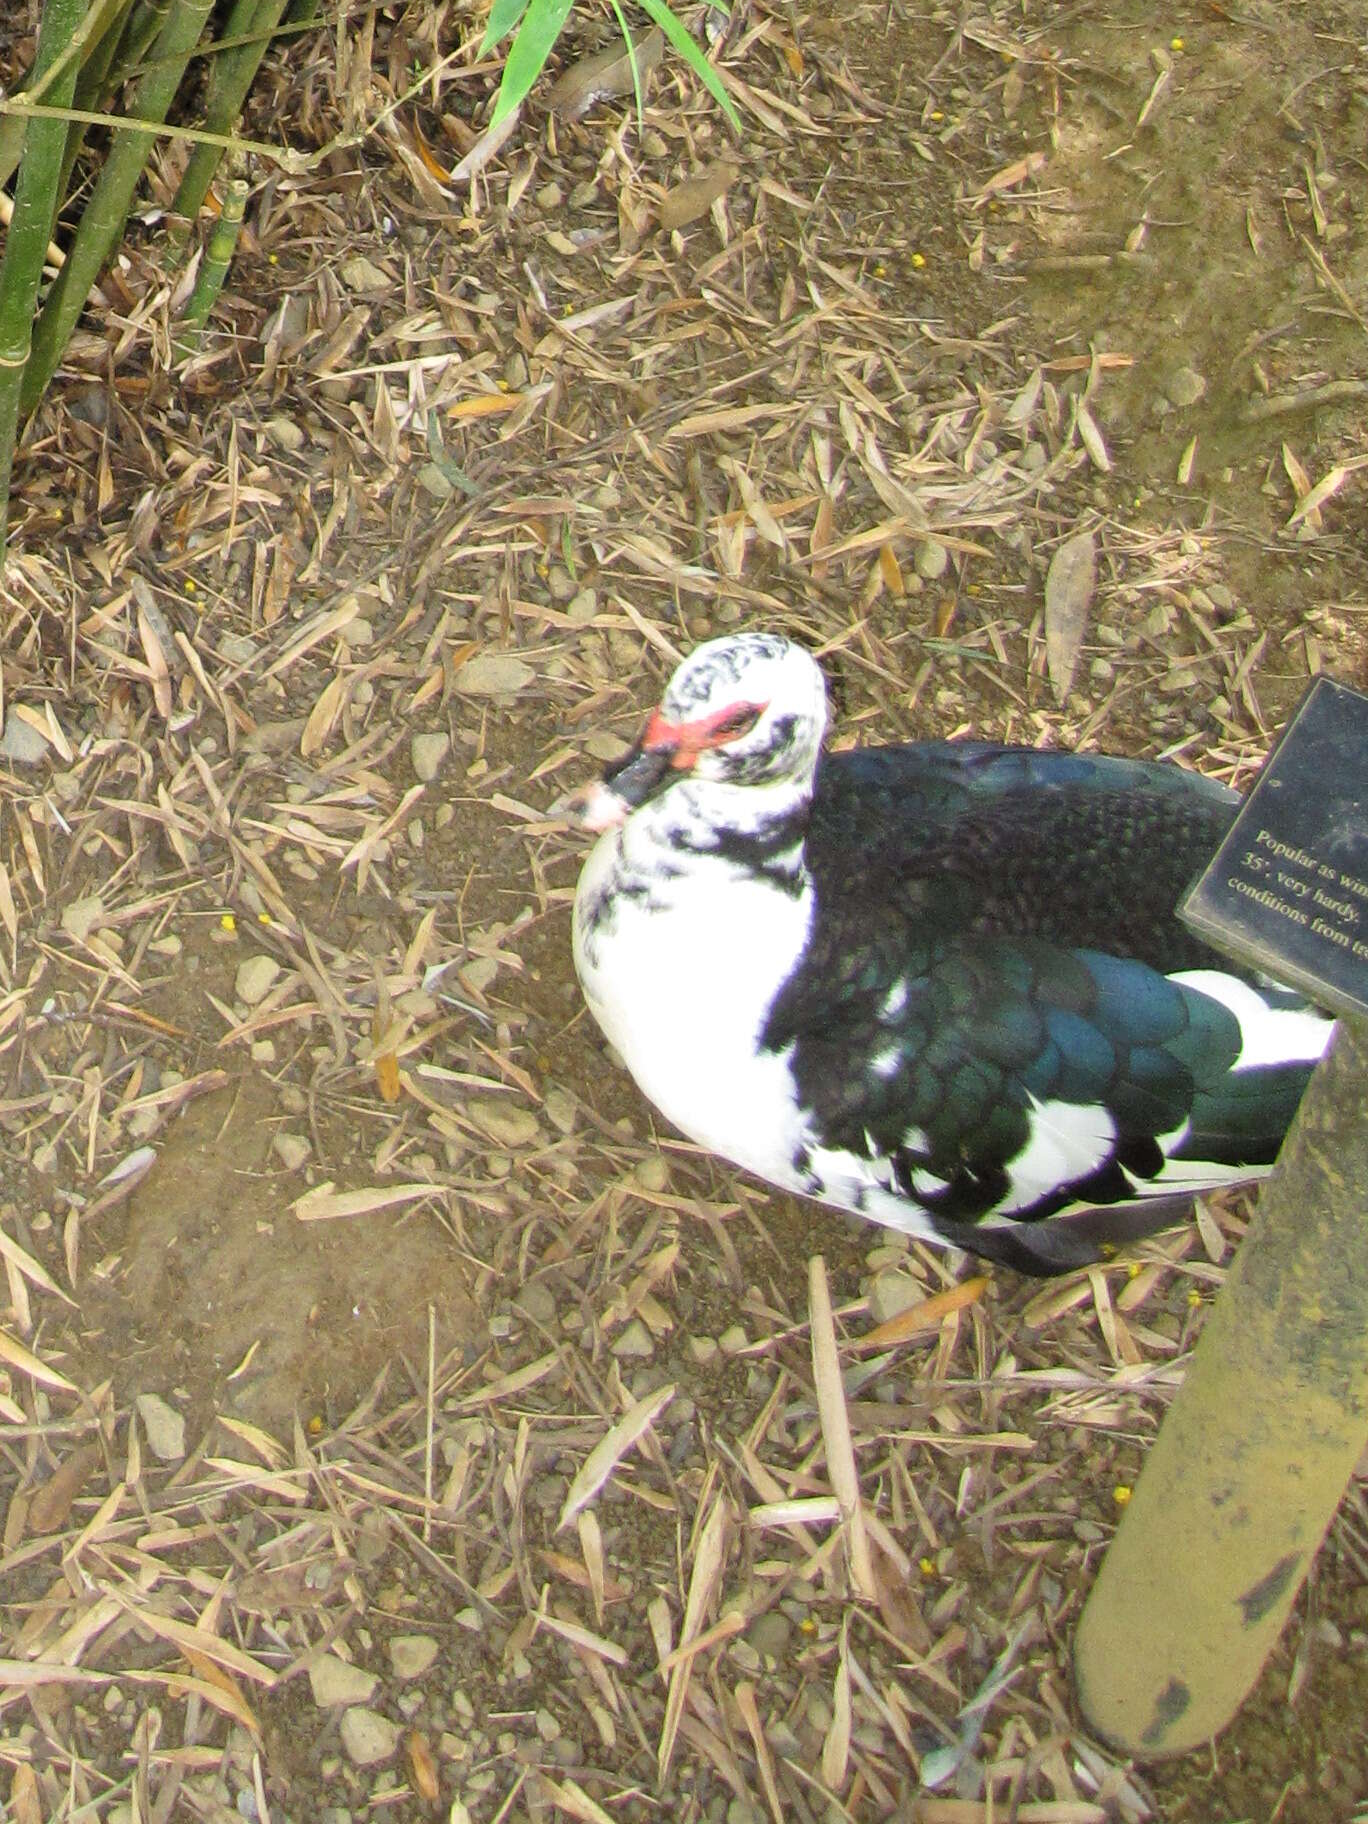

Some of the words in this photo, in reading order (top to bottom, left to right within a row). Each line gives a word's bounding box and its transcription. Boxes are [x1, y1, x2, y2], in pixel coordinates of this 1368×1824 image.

[1256, 830, 1317, 868] Popular
[1318, 865, 1336, 879] as
[1228, 878, 1308, 924] conditions
[1310, 918, 1349, 946] from
[1278, 872, 1311, 897] very
[1313, 888, 1359, 922] hardy.
